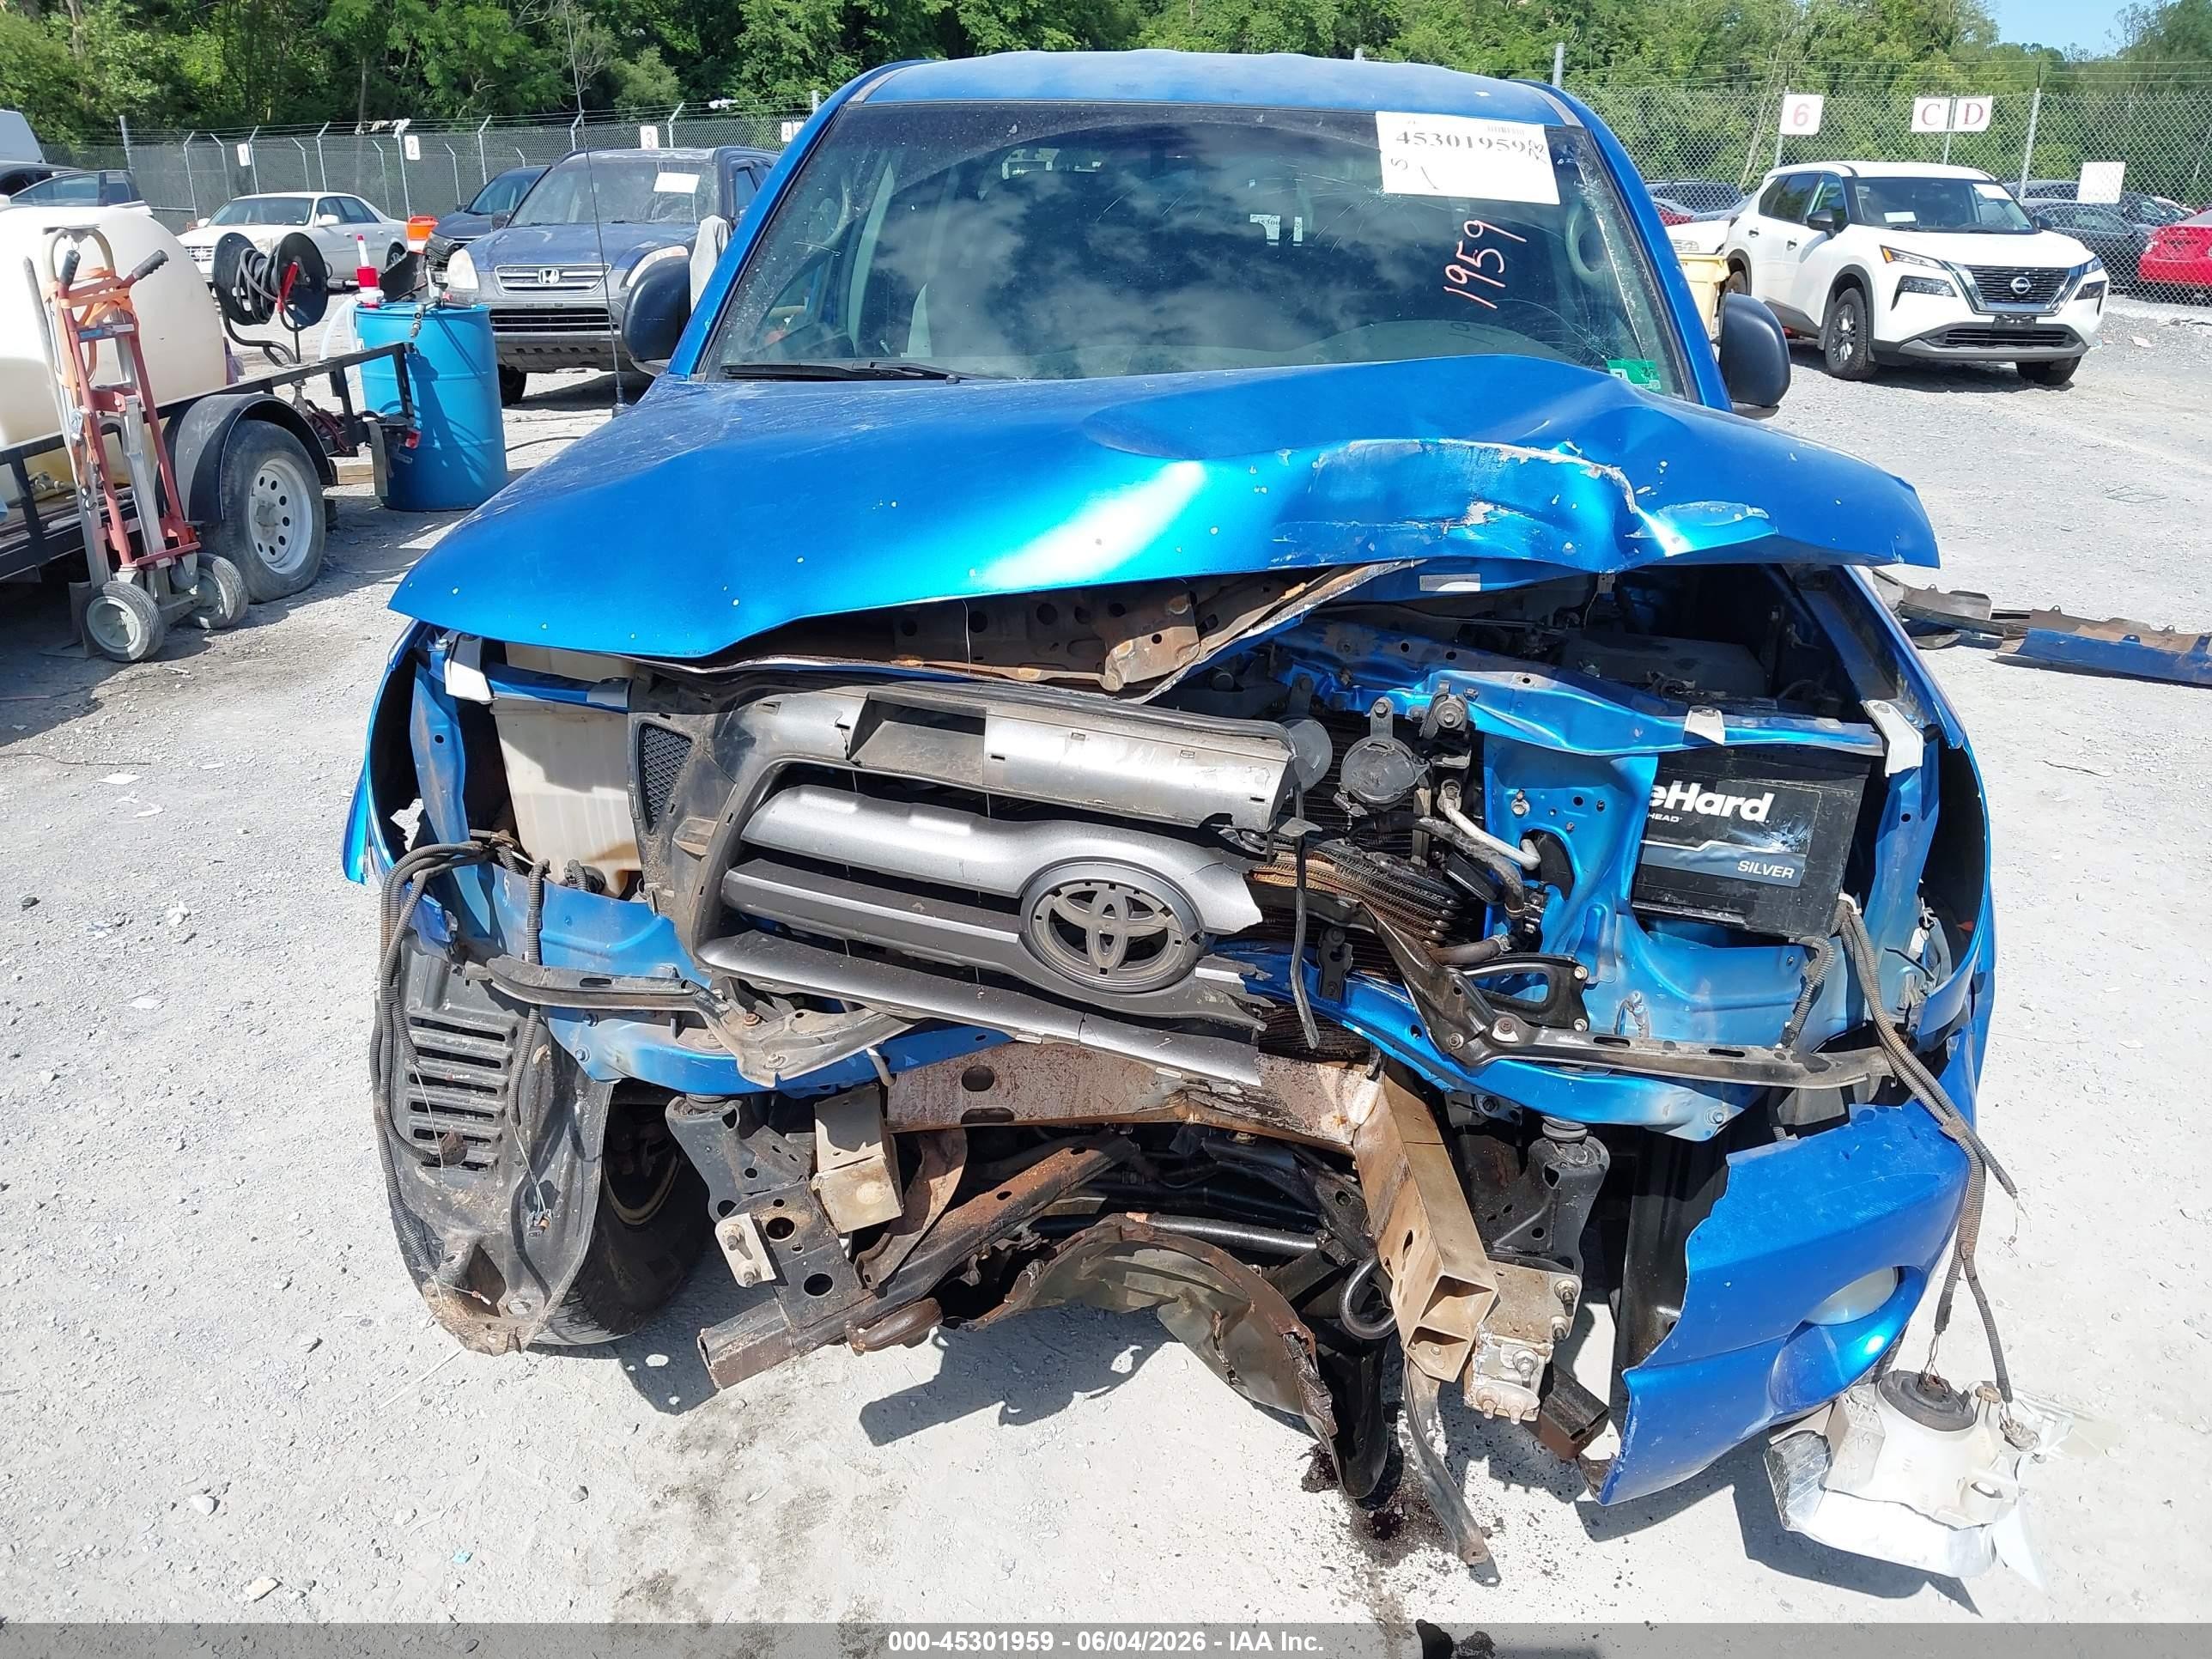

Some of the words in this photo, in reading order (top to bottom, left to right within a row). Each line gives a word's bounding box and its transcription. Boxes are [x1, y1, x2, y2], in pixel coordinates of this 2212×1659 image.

[1793, 103, 1810, 127] 6
[1921, 103, 1941, 125] C
[1963, 102, 1984, 125] D
[409, 140, 416, 155] 2
[1395, 131, 1527, 153] 45301959
[1443, 219, 1528, 309] 1959
[1737, 860, 1795, 879] SILVER
